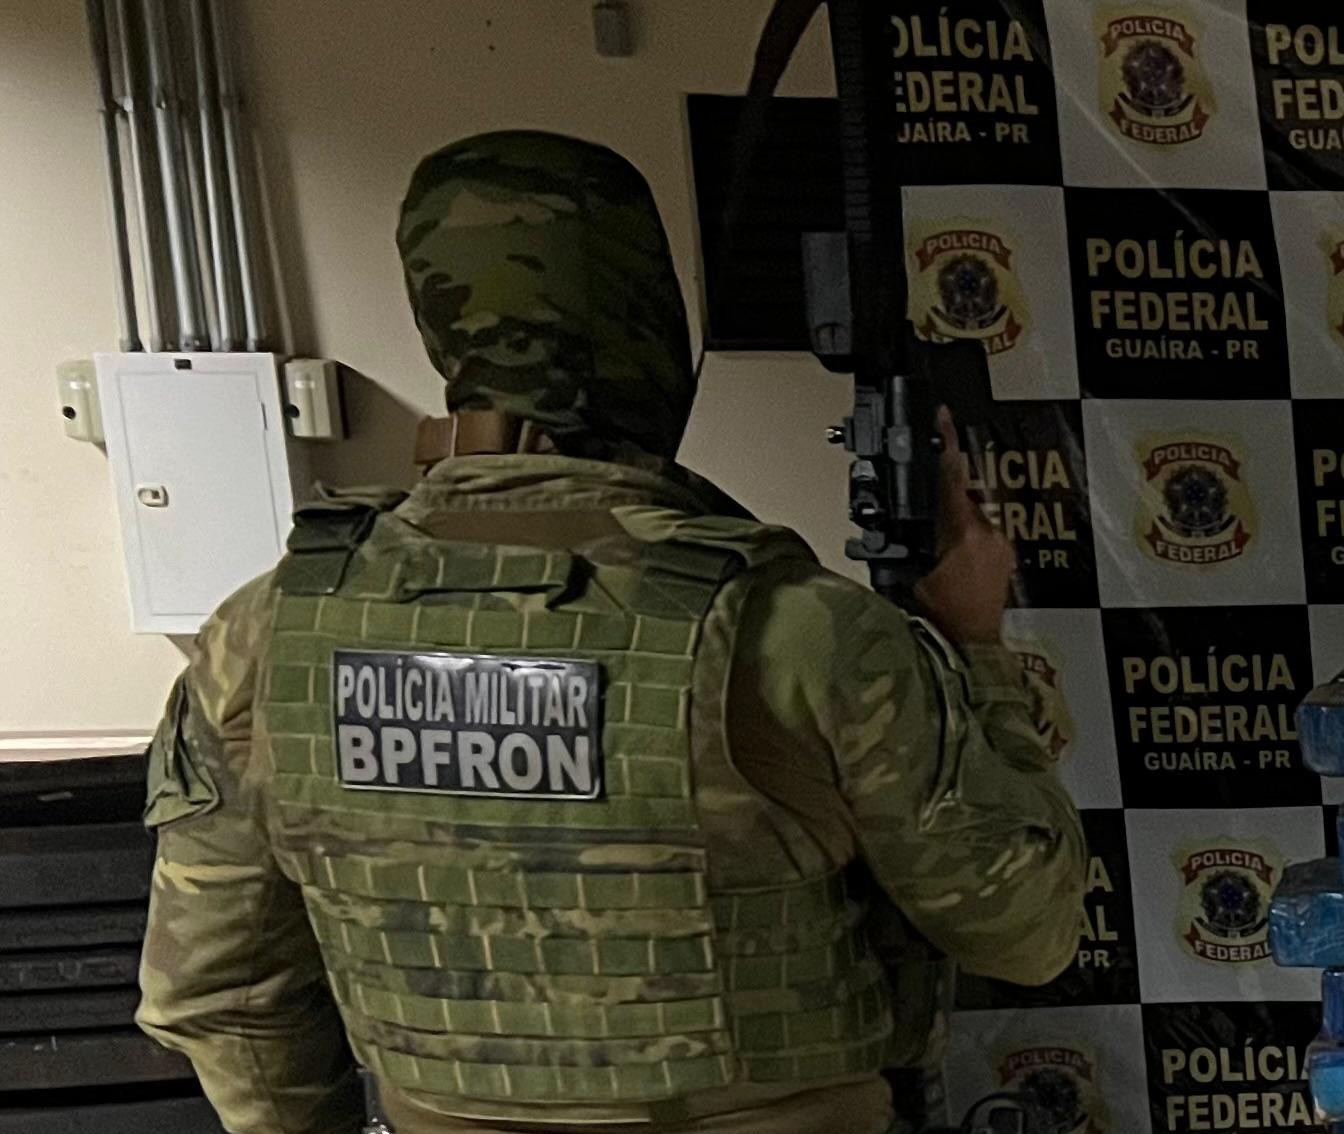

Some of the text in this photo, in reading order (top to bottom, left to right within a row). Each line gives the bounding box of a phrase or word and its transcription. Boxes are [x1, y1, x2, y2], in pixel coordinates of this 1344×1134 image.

[890, 6, 1034, 62] OLÍCIA
[994, 121, 1030, 144] PR
[1120, 121, 1199, 143] FEDERAL
[1086, 230, 1263, 280] POLÍCIA
[1090, 290, 1268, 332] FEDERAL
[1105, 334, 1204, 361] GUAÍRA
[1227, 339, 1259, 360] PR
[1038, 549, 1070, 569] PR
[1155, 541, 1241, 562] FEDERAL
[1122, 646, 1297, 695] POLÍCIA
[465, 672, 588, 728] MILITAR
[1128, 703, 1297, 744] FEDERAL
[338, 724, 592, 791] BPFRON
[1143, 748, 1236, 771] GUAÍRA
[1259, 750, 1291, 769] PR
[1078, 949, 1111, 969] PR
